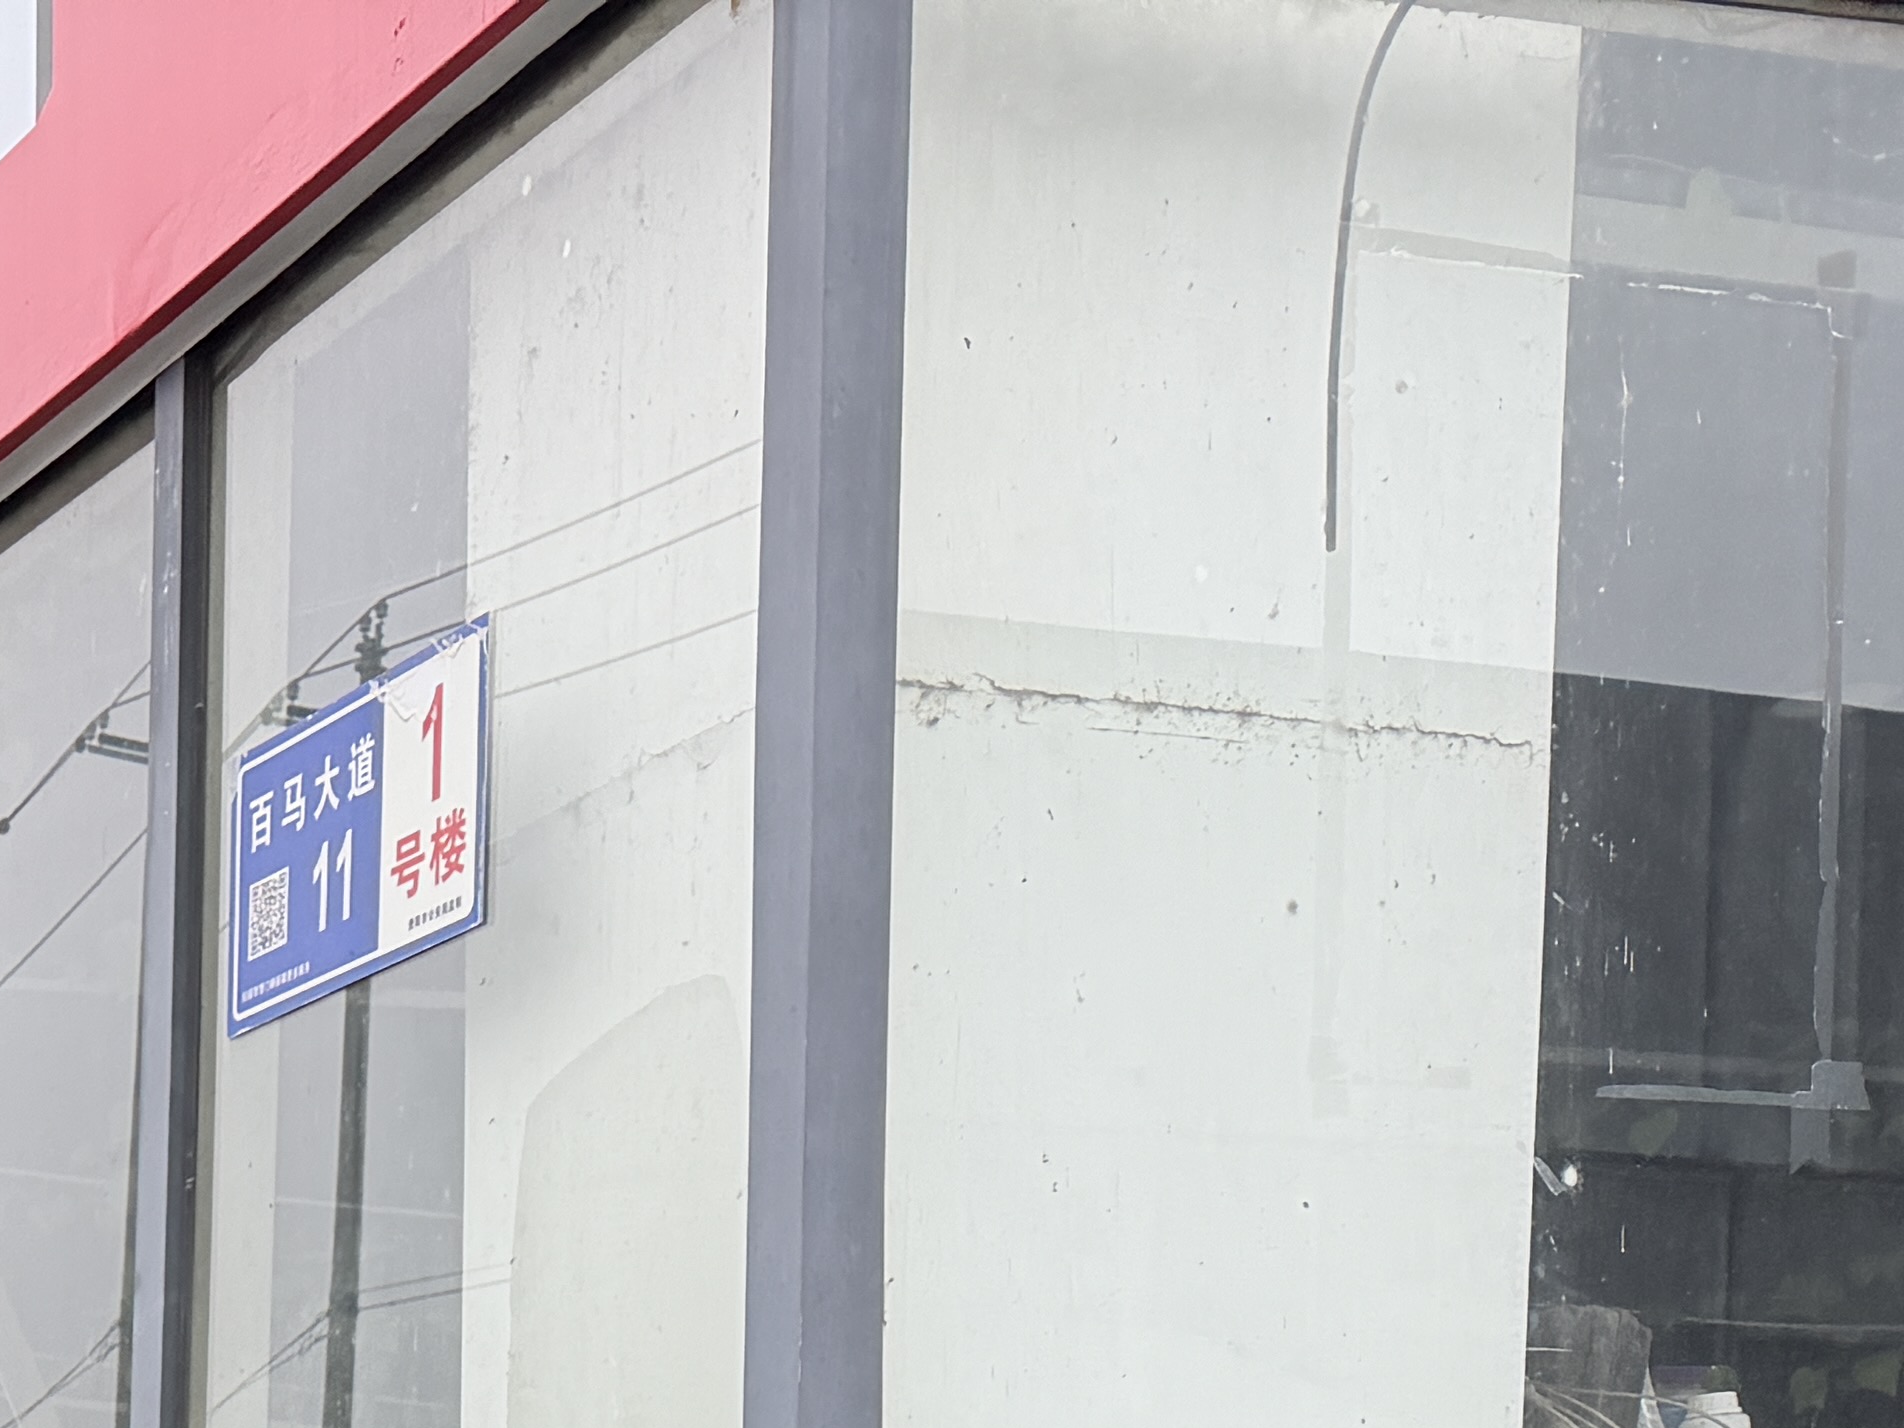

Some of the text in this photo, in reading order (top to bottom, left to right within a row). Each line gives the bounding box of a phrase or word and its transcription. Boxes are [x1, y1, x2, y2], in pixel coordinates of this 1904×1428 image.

[249, 733, 376, 854] 百马大道
[422, 683, 444, 802] 1
[312, 828, 353, 933] 11
[390, 807, 467, 899] 号楼
